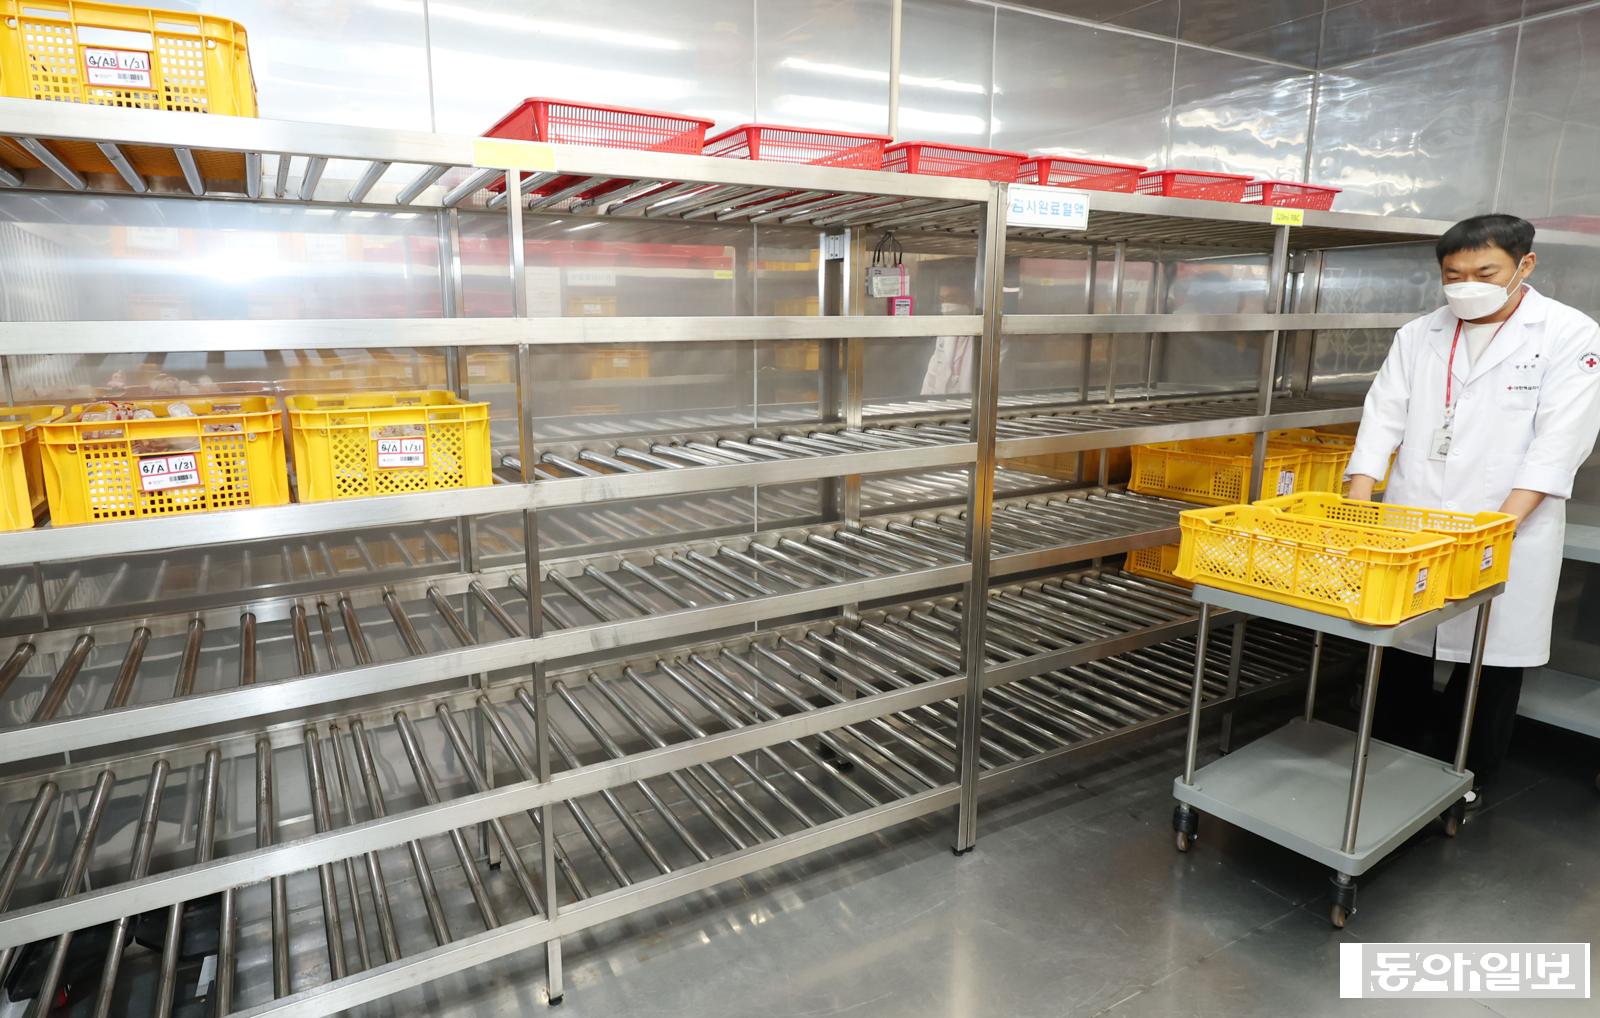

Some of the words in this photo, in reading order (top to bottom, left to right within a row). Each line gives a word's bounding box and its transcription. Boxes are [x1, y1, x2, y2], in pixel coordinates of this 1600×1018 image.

[124, 57, 146, 70] 1/31
[404, 443, 422, 452] 1/31
[174, 460, 193, 471] 1/31
